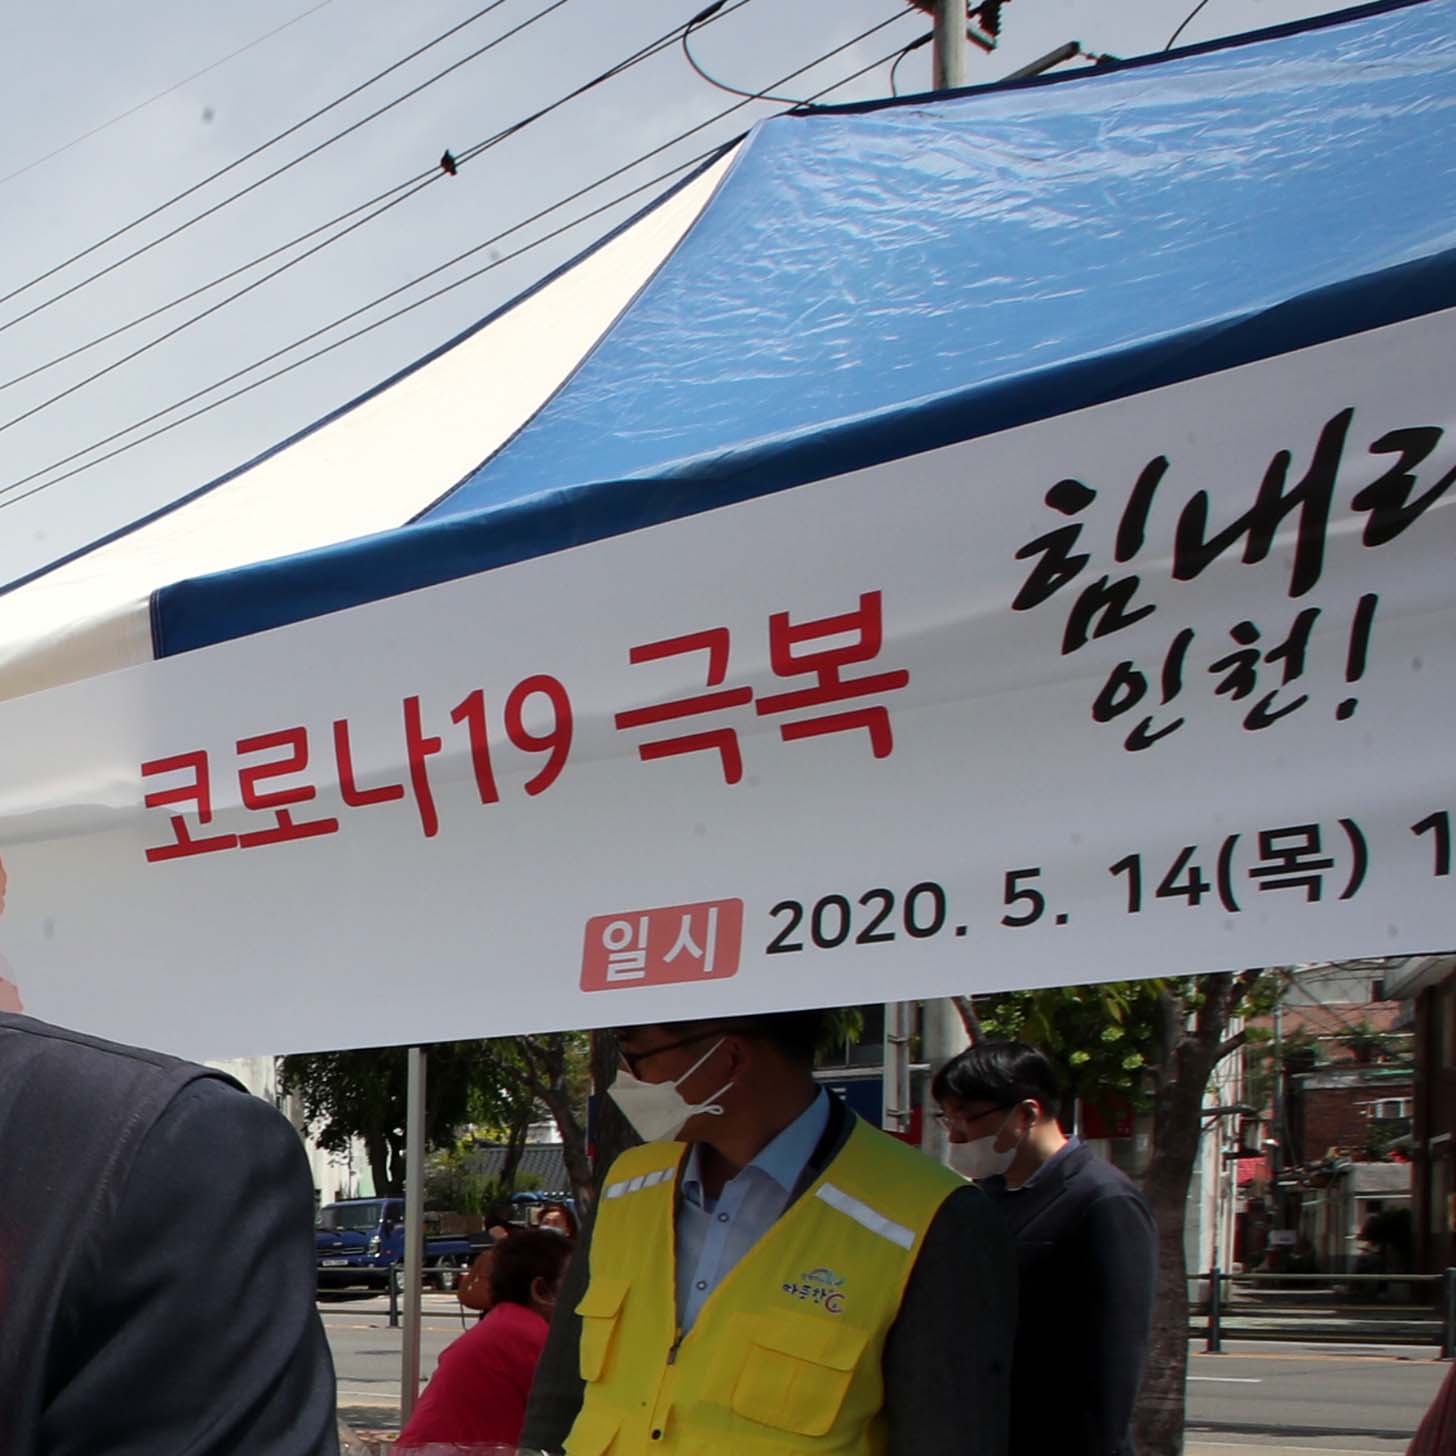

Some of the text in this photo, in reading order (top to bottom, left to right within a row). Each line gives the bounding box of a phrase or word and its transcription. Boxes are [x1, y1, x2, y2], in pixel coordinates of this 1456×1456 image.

[140, 592, 909, 863] 코로나19 극복
[1091, 593, 1380, 753] 인천!
[601, 906, 719, 983] 일시
[765, 880, 969, 955] 2020.
[999, 866, 1070, 928] 5.
[1107, 817, 1369, 914] 14(목)
